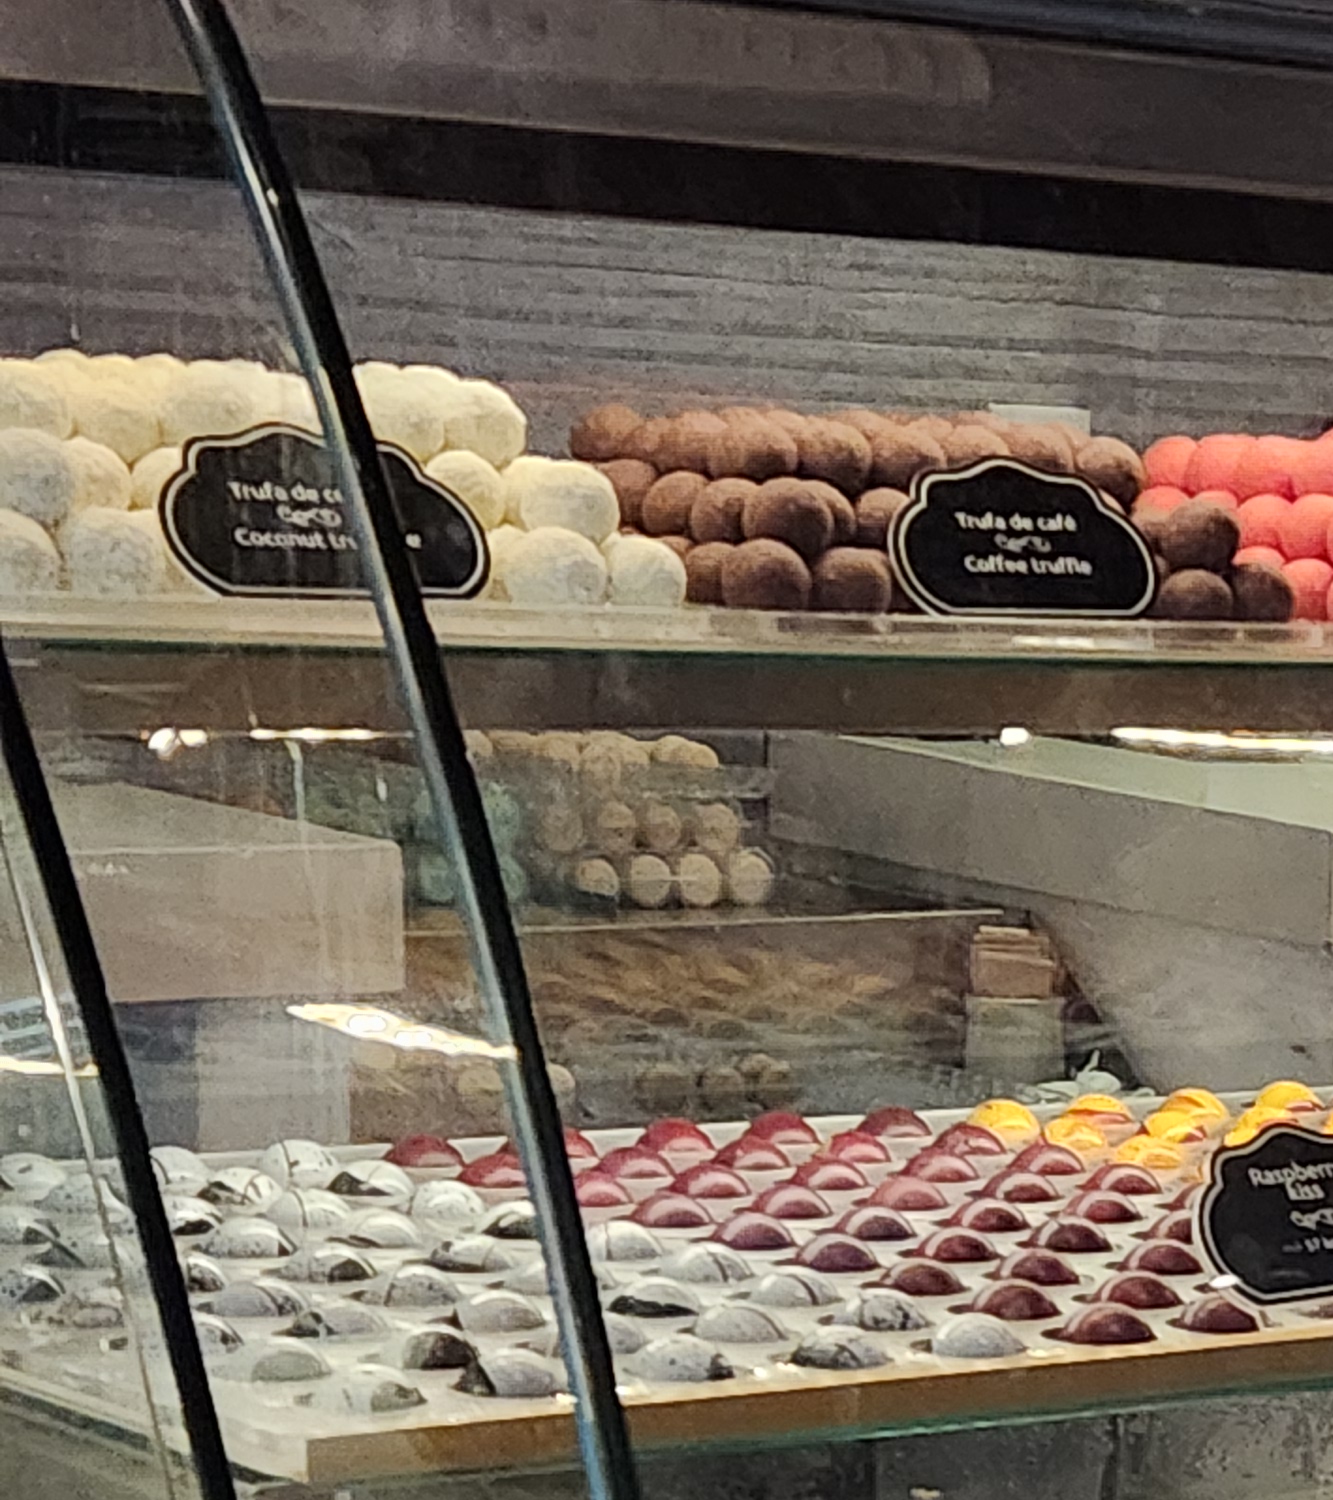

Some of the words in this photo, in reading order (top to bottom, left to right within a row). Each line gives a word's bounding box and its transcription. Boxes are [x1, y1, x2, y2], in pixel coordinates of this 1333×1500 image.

[229, 482, 287, 501] Trufa
[292, 483, 319, 502] de
[955, 512, 1005, 530] Trufa
[1010, 514, 1033, 530] de
[234, 528, 327, 550] Coconut
[964, 555, 1028, 574] Coffee
[1032, 557, 1092, 575] truffle
